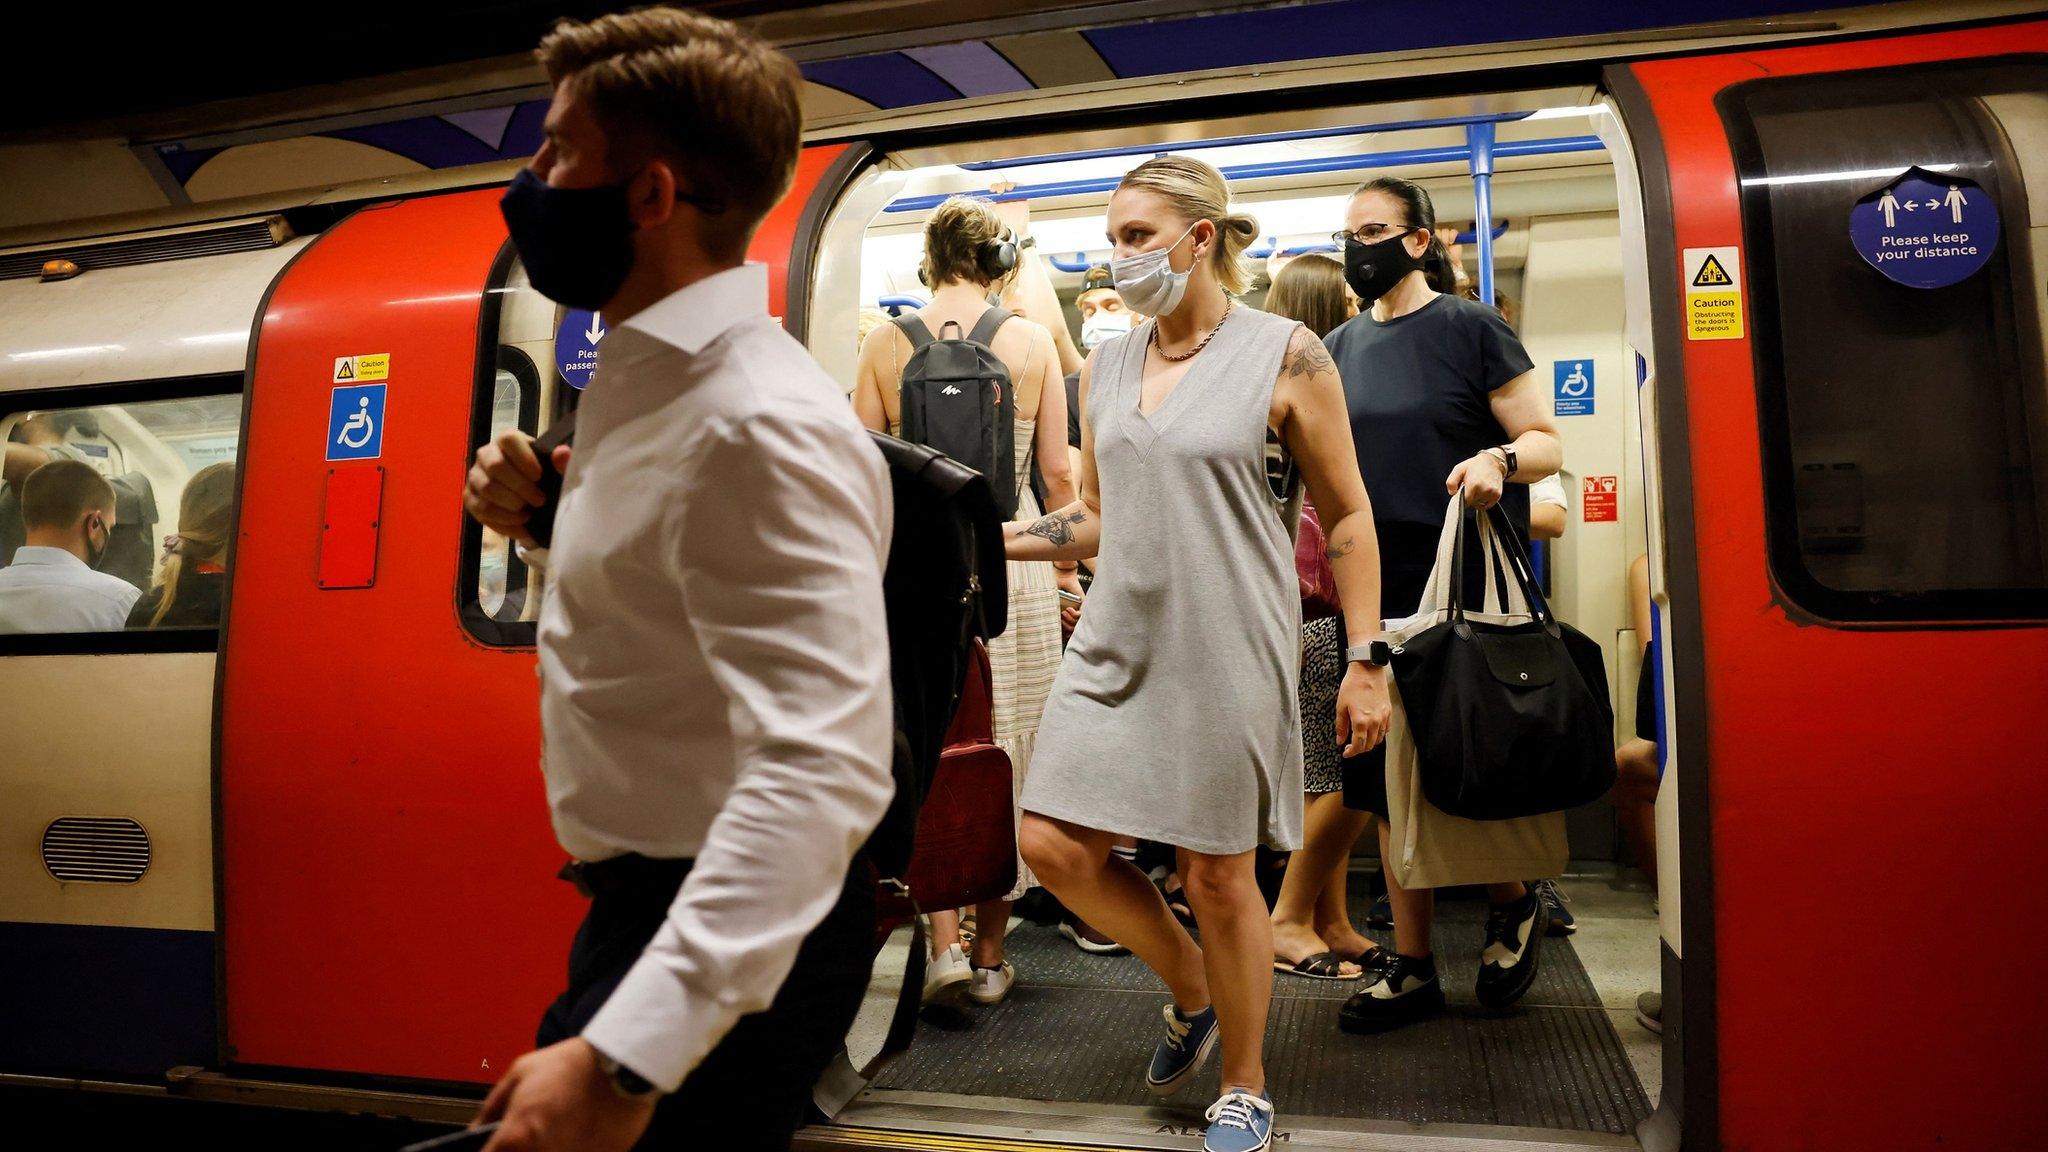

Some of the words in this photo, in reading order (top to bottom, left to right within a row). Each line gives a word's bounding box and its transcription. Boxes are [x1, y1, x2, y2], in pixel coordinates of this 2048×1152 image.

[1881, 235, 1929, 247] Please
[1933, 233, 1969, 245] keep
[1876, 250, 1910, 263] your
[1914, 246, 1978, 258] distance
[1693, 298, 1735, 308] Caution
[1694, 311, 1736, 319] Obstructing
[577, 349, 599, 359] Plea
[360, 360, 385, 369] Caution
[565, 362, 598, 373] passen
[481, 1058, 490, 1069] A
